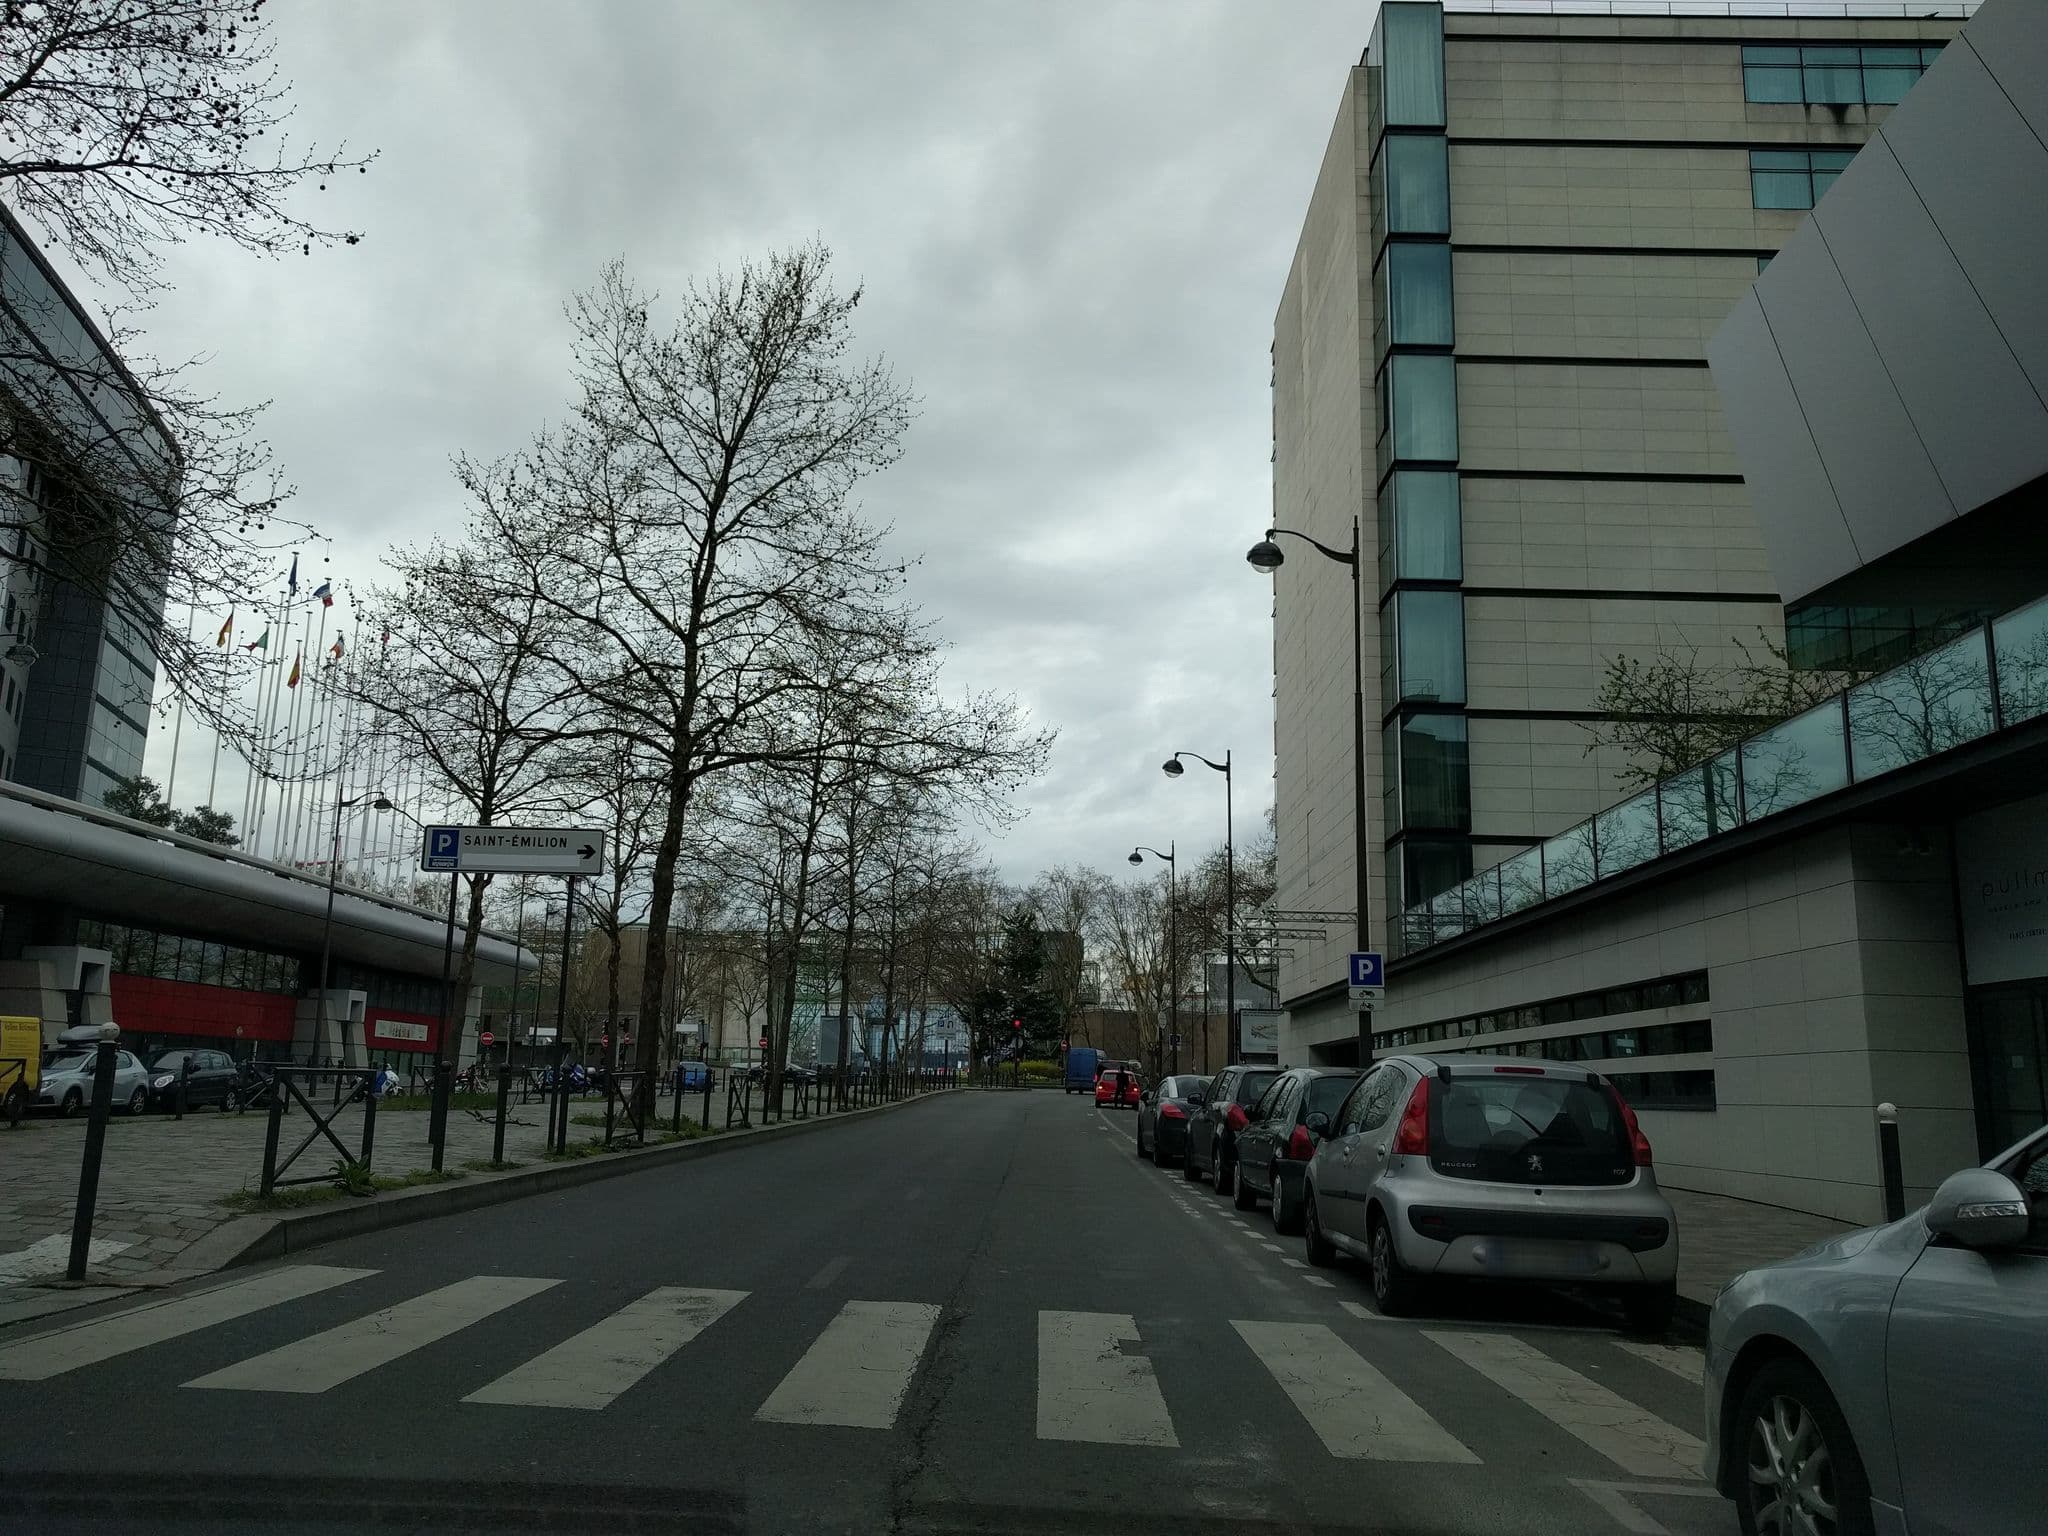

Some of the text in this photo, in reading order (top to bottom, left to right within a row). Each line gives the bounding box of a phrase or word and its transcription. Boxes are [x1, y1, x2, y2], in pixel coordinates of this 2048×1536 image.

[437, 833, 567, 853] P SAINT-ÉMILION
[1358, 959, 1374, 981] P
[1440, 1161, 1478, 1169] PEUGEOT
